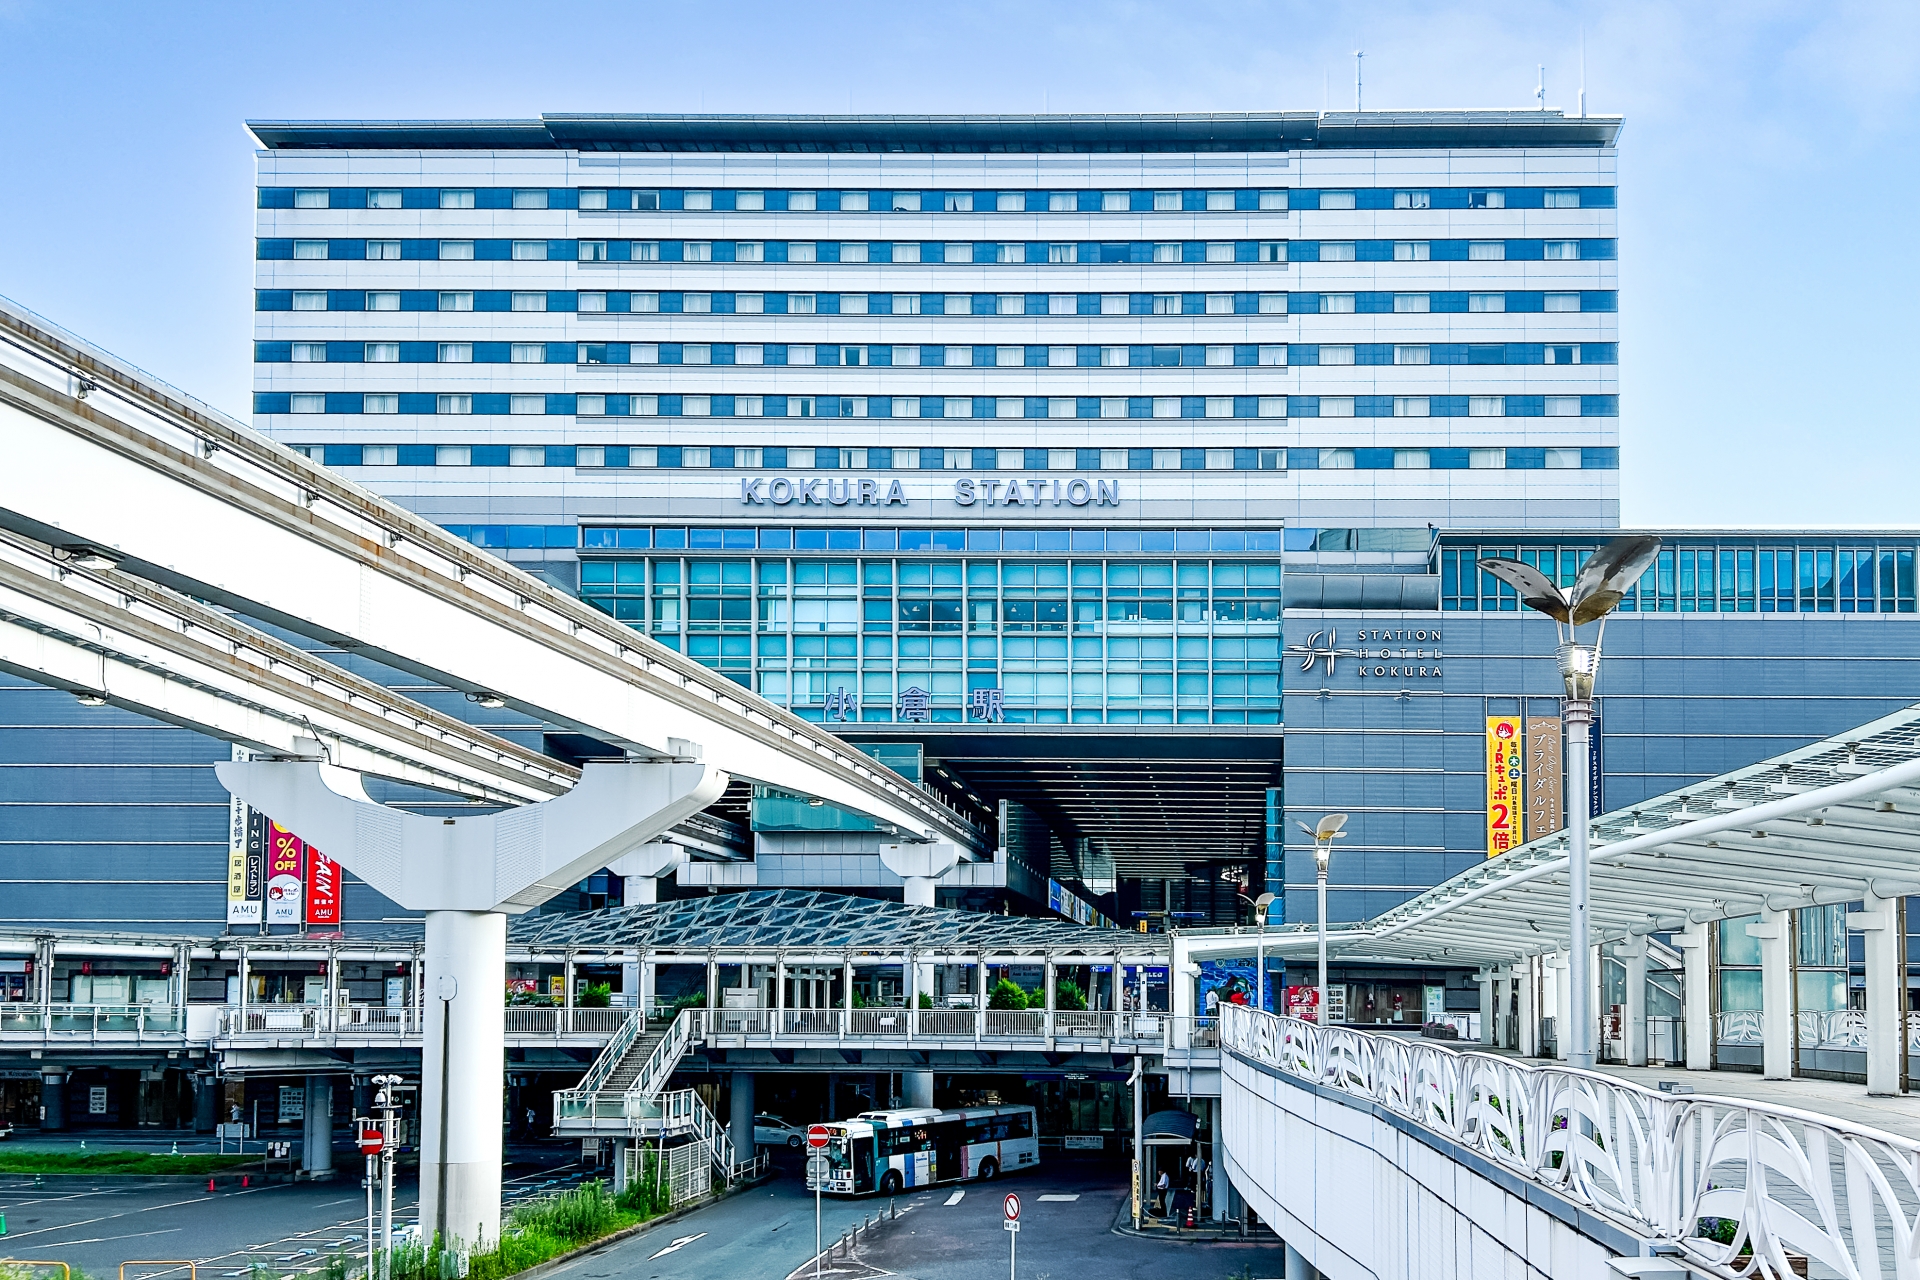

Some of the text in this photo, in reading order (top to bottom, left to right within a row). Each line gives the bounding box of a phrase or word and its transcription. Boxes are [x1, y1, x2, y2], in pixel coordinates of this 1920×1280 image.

[741, 477, 1120, 506] KOKURA STATION
[1358, 630, 1442, 641] STATION
[1358, 648, 1443, 660] HOTEL
[1358, 665, 1443, 677] KOKURA
[824, 686, 1004, 720] 小倉駅
[1494, 742, 1509, 801] JRキューポ
[276, 836, 297, 859] %
[274, 860, 297, 871] OFF
[249, 858, 258, 895] レストラン
[232, 905, 258, 914] AMU
[275, 908, 293, 916] AMU
[314, 908, 333, 916] AMU
